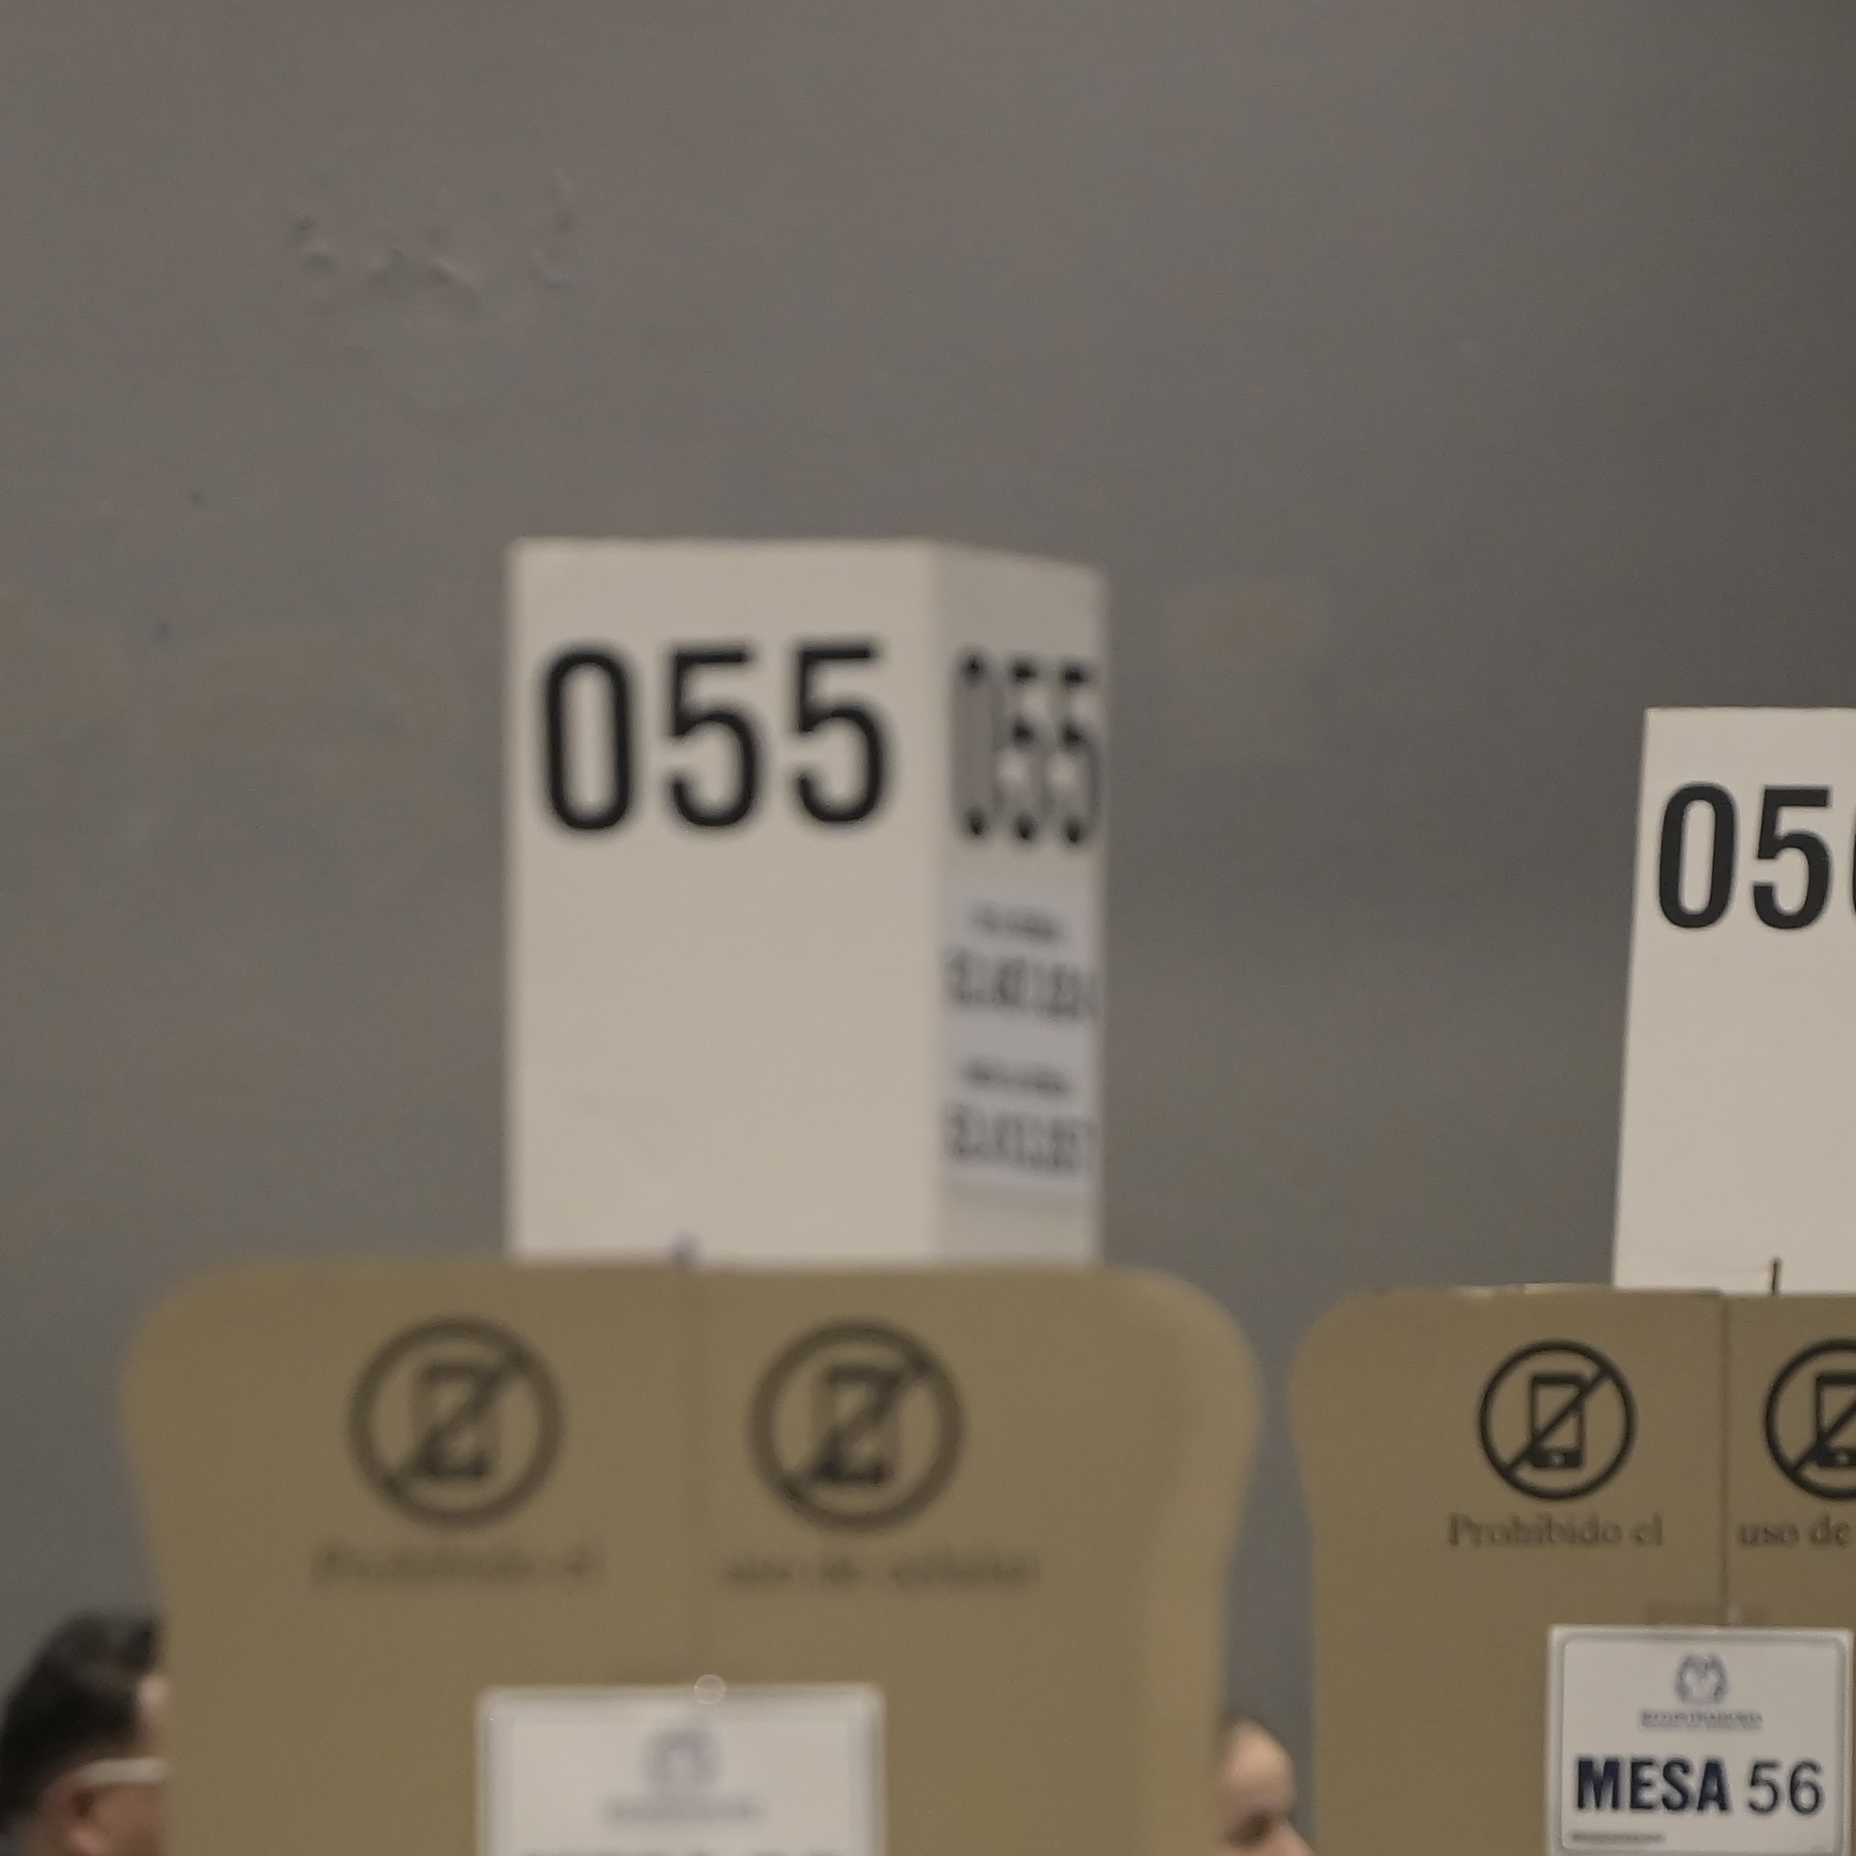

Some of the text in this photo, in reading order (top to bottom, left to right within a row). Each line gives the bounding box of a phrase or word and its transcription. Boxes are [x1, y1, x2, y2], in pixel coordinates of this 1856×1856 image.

[544, 637, 889, 832] 055
[1447, 1514, 1623, 1547] Prohibido
[1738, 1522, 1799, 1547] uso
[1808, 1514, 1850, 1547] de
[1578, 1759, 1821, 1814] MESA 56
